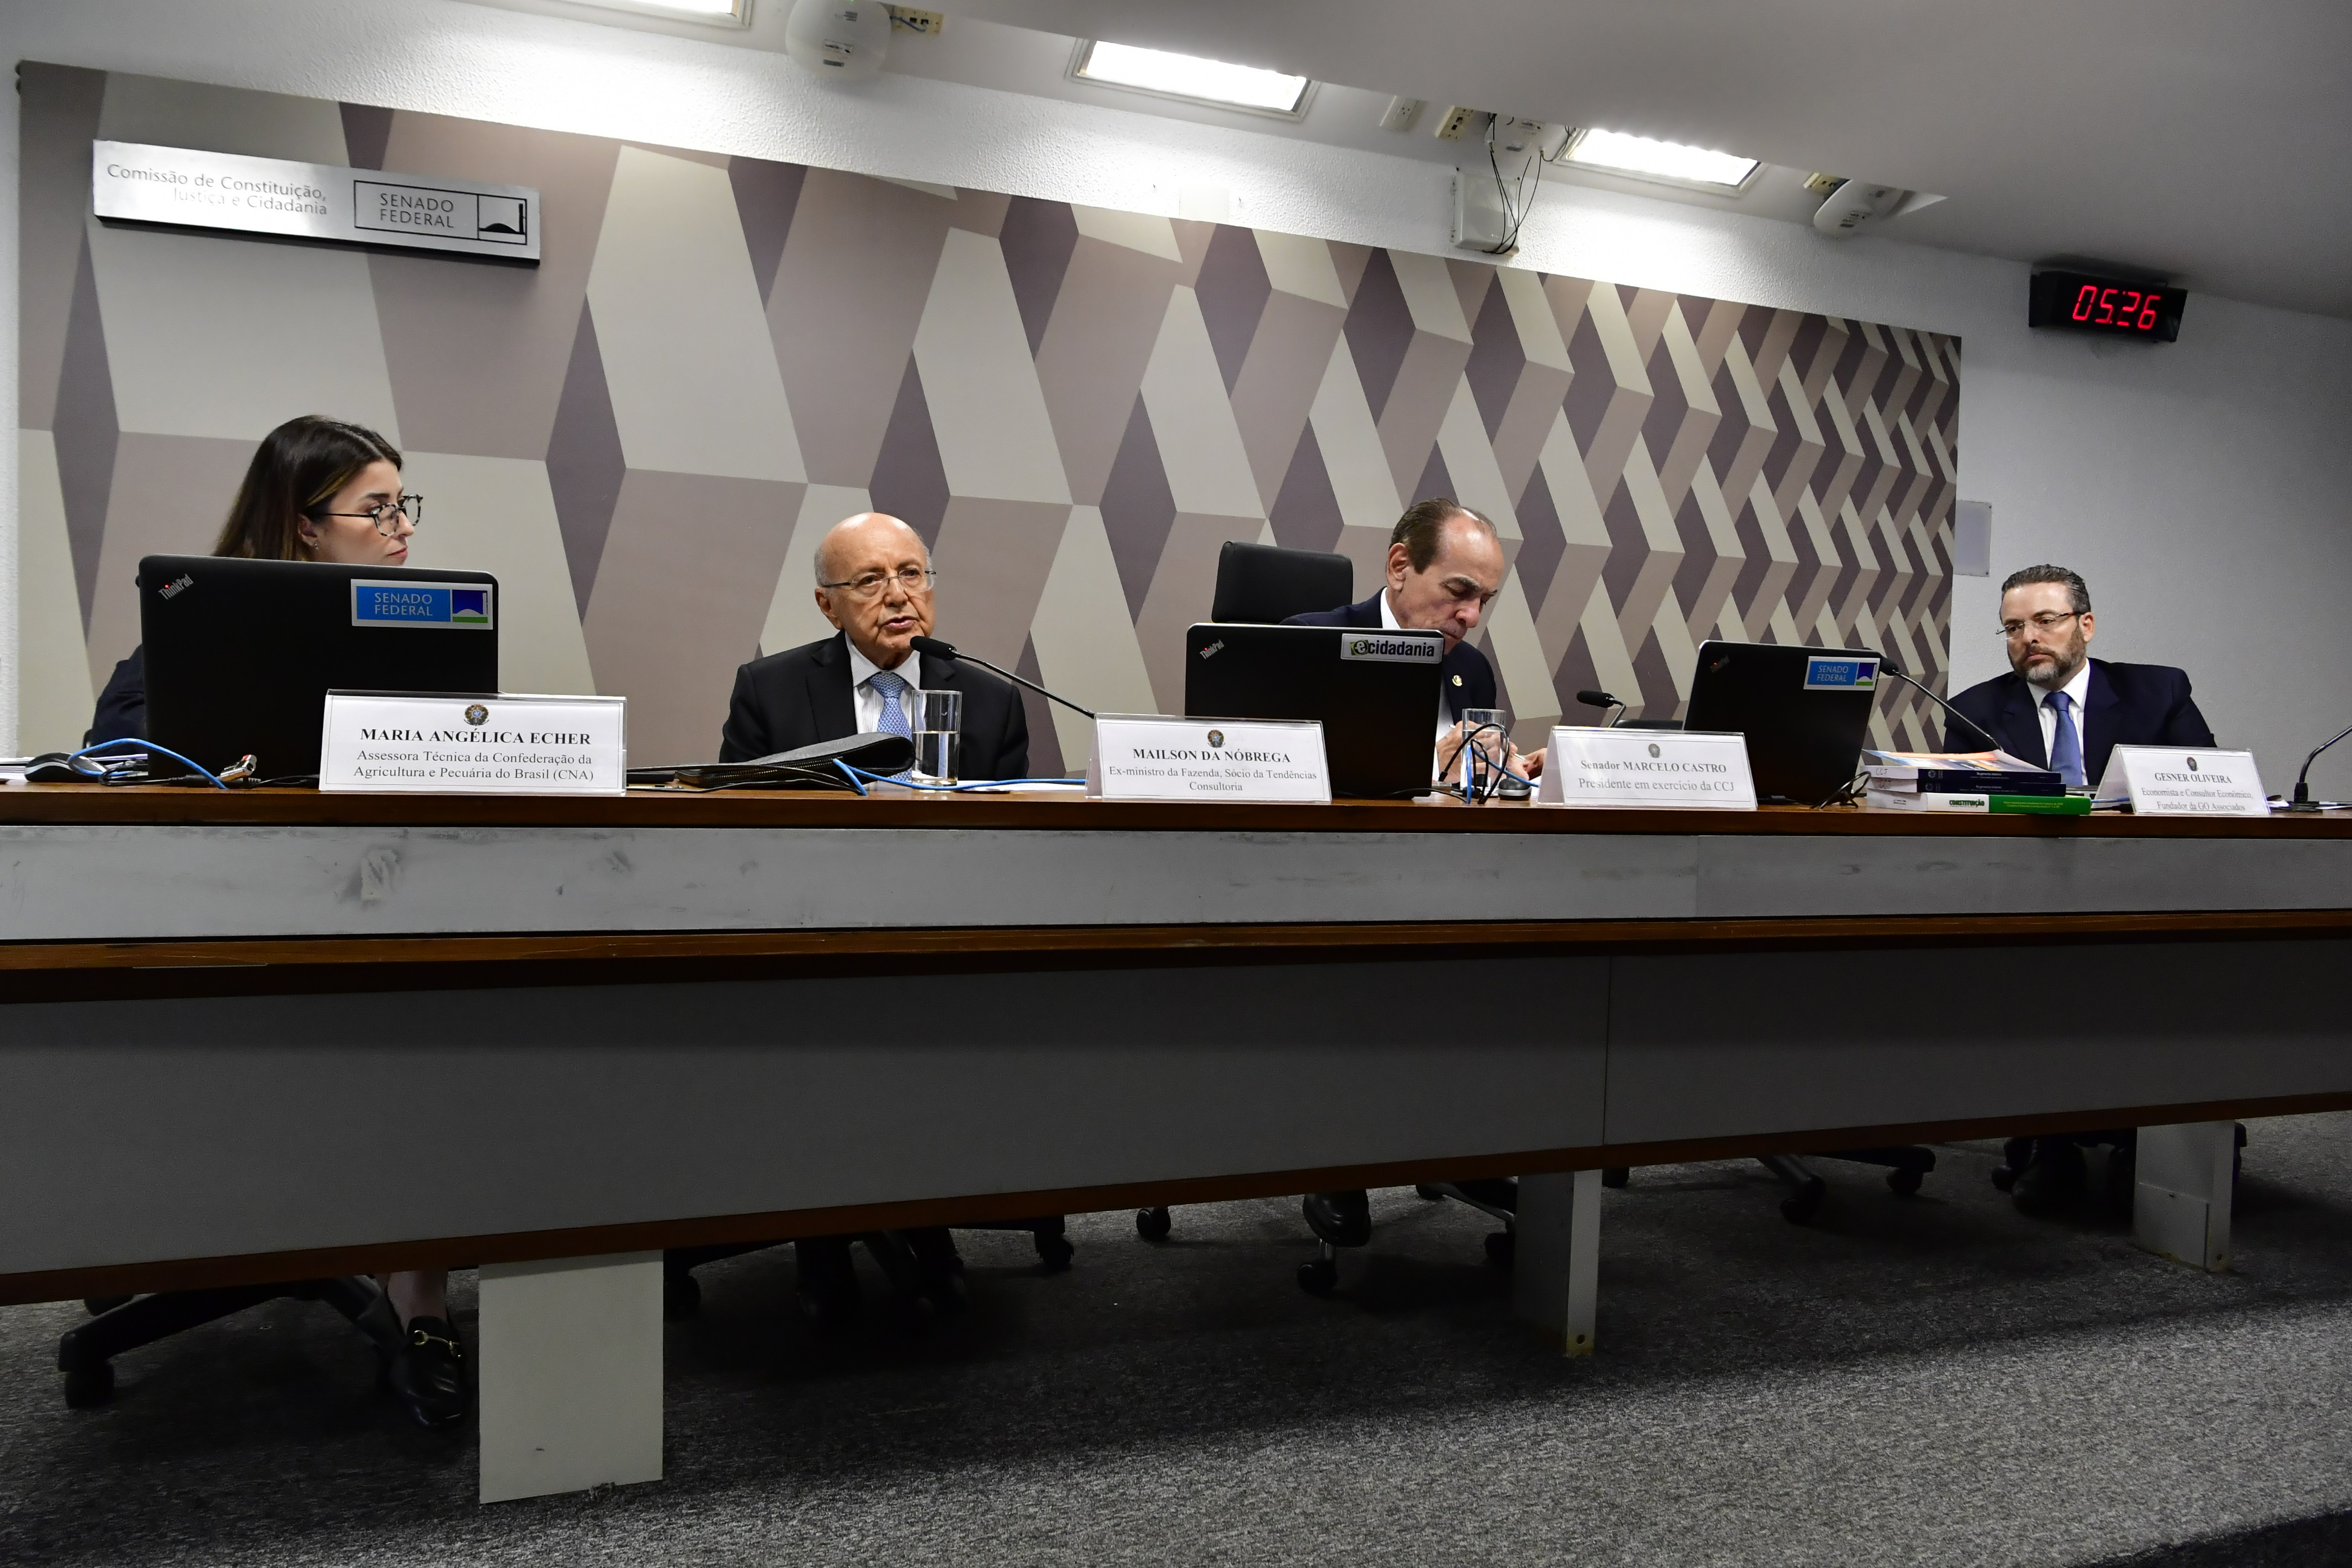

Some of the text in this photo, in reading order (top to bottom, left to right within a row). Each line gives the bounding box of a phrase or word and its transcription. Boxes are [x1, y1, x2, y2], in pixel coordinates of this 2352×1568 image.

[107, 164, 326, 201] Comissão de Constituição,
[174, 187, 327, 215] Justiça e Cidadania
[380, 193, 454, 213] SENADO
[380, 208, 454, 228] FEDERAL
[158, 573, 193, 599] ThinkPad
[375, 592, 433, 604] SENADO
[375, 604, 433, 616] FEDERAL
[1200, 639, 1224, 659] ThinkPad
[1818, 665, 1848, 674] SENADO
[1816, 674, 1847, 682] FEDERAL
[360, 728, 591, 745] MARIA ANGÉLICA ECHER
[357, 750, 591, 766] Assessora Técnica da Confederação da
[1133, 749, 1291, 763] MAILSON DA NÓBREGA
[1109, 766, 1317, 779] Ex-ministro da Fazenda, Sócio da Tendências
[1580, 760, 1727, 773] Senador MARCELO CASTRO
[353, 766, 425, 779] Agricultura
[440, 767, 492, 778] Pecuária
[495, 768, 510, 778] do
[515, 768, 549, 779] Brasil
[553, 769, 594, 782] (CNA)
[2154, 772, 2232, 783] GESNER OLIVEIRA
[1189, 781, 1243, 791] Consultoria
[1578, 778, 1632, 789] Presidente
[1652, 780, 1698, 791] exercício
[1700, 781, 1712, 791] da
[1714, 781, 1734, 791] CCJ
[2141, 788, 2179, 796] Economista
[2218, 790, 2253, 799] Econômico,
[1949, 799, 1985, 808] CONSTITUIÇÃO
[2211, 803, 2246, 811] Associados
